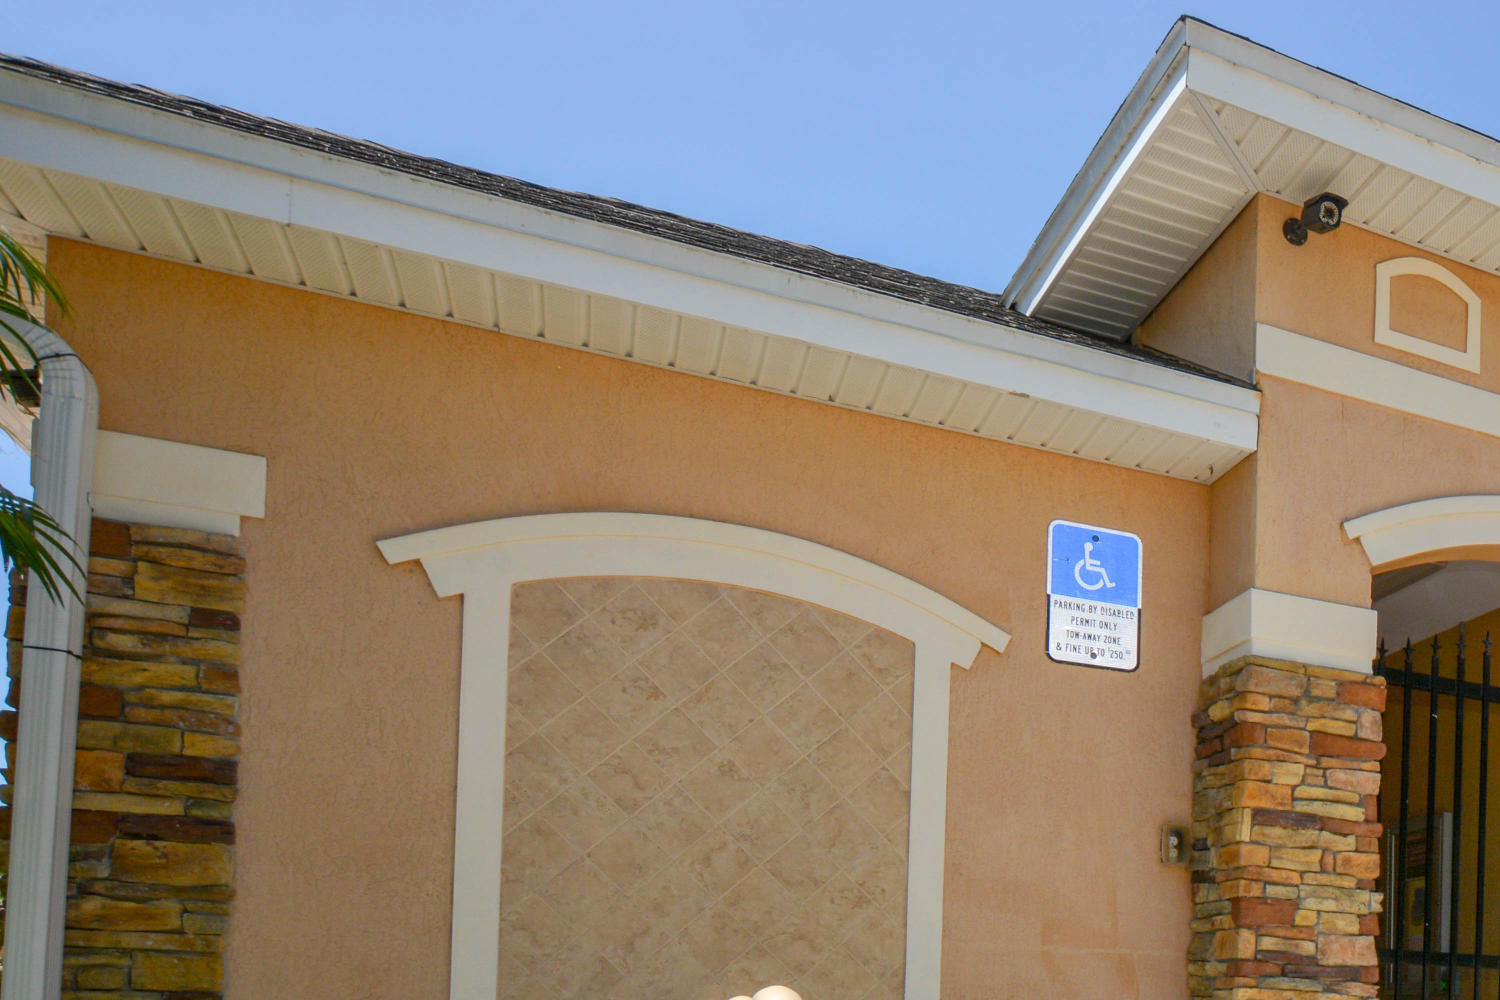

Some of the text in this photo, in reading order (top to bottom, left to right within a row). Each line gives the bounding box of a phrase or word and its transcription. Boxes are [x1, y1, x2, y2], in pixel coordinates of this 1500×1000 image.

[1054, 599, 1135, 620] PARKING BY DISABLED
[1070, 616, 1118, 631] PERMIT ONLY
[1066, 629, 1121, 646] TOW-AWAY ZONE
[1056, 642, 1062, 651] &
[1065, 643, 1081, 654] FINE
[1084, 646, 1094, 655] UP
[1097, 648, 1105, 657] TO
